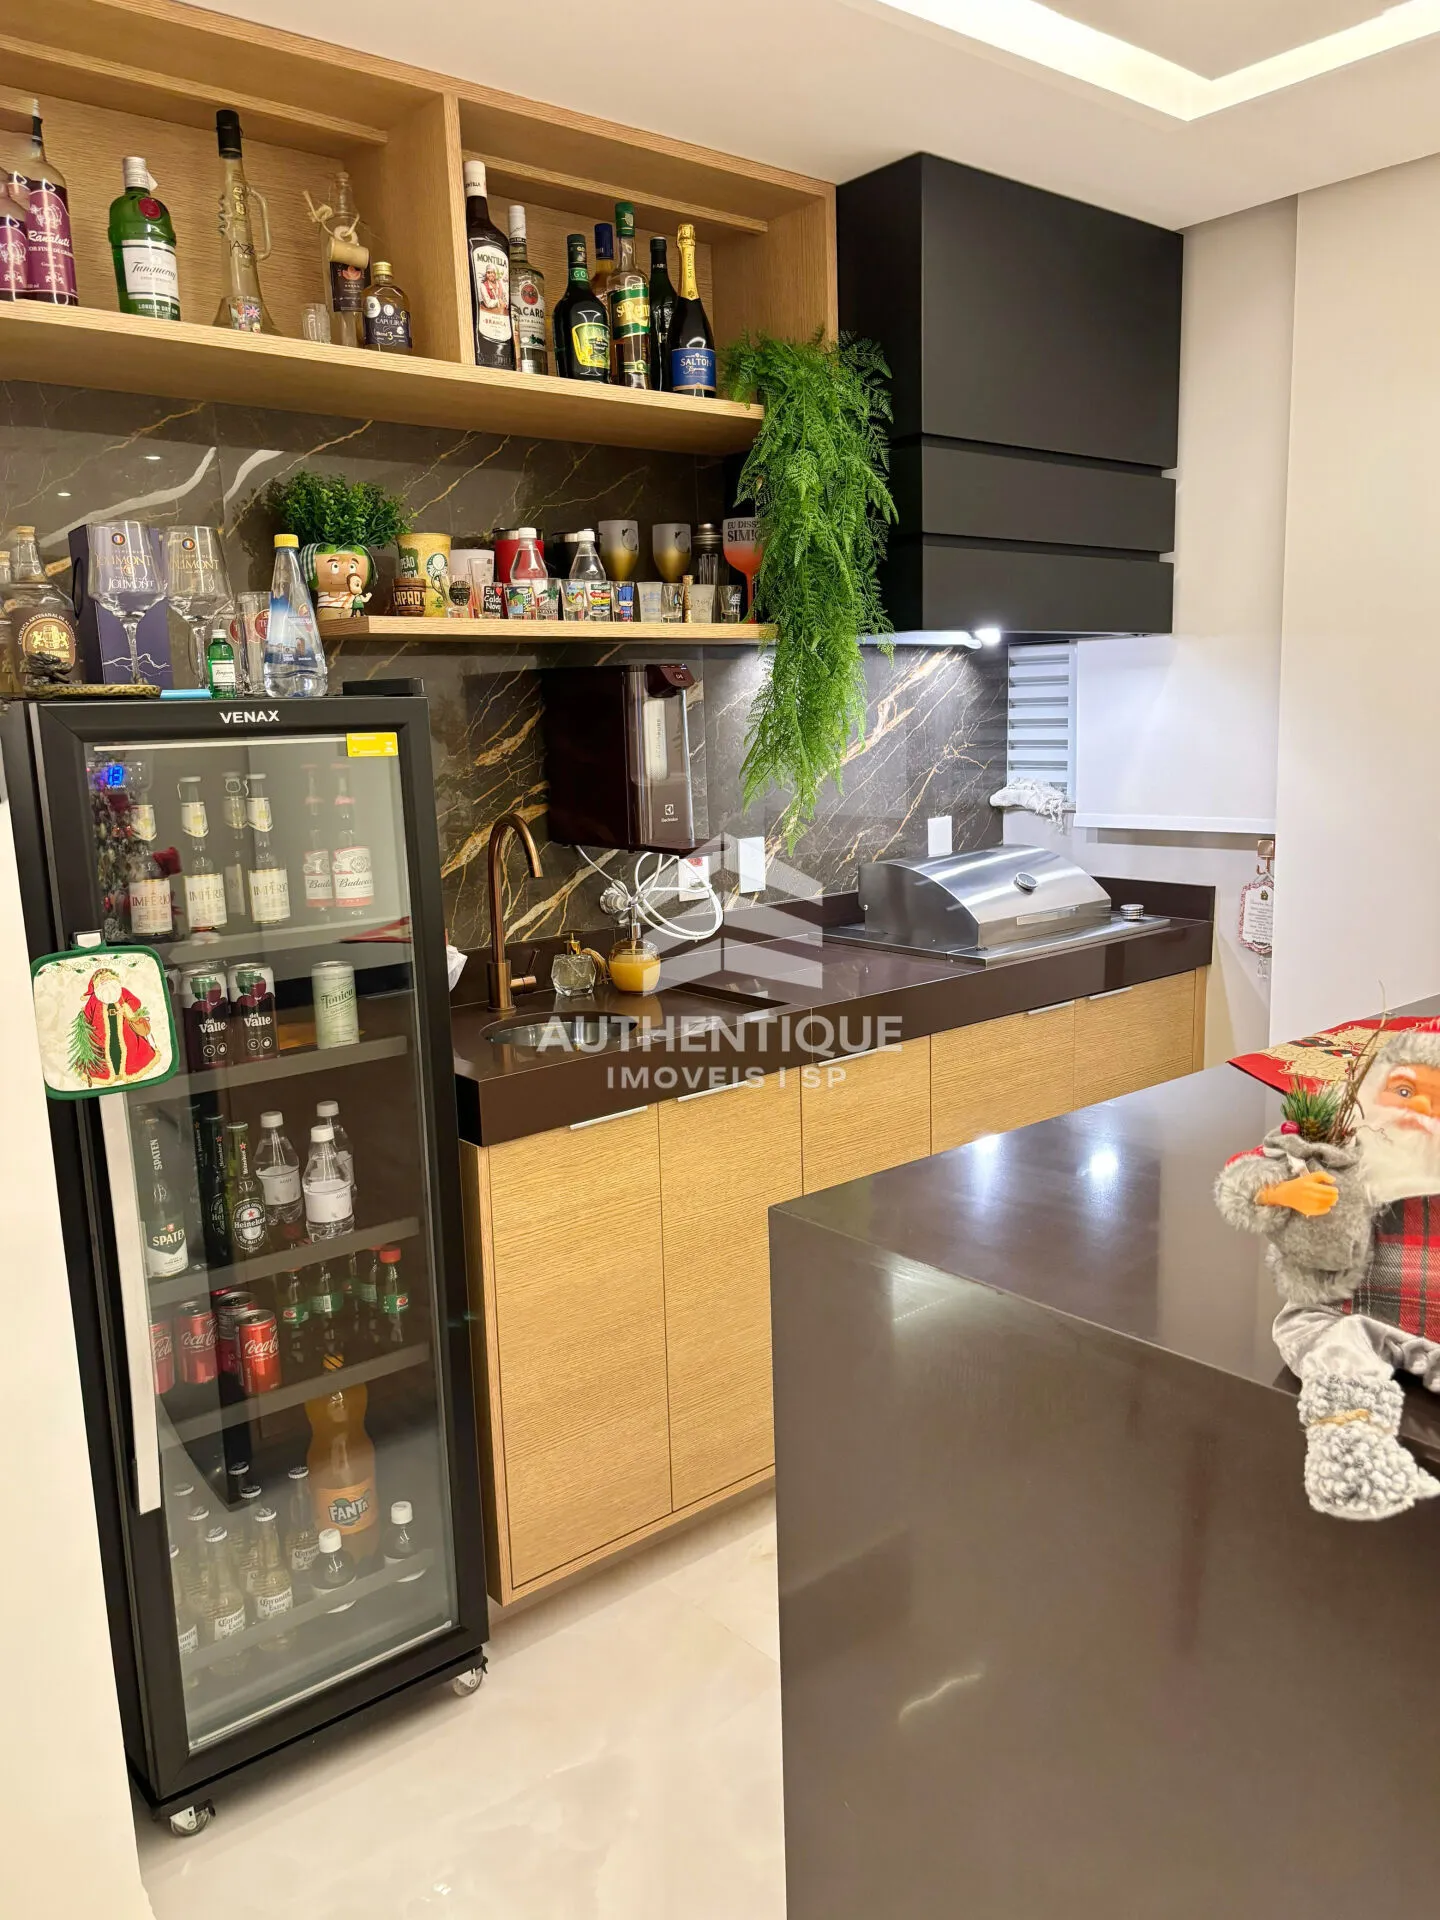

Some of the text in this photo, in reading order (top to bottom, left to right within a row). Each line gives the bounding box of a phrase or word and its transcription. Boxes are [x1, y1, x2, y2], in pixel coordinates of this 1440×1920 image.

[477, 254, 508, 268] MONTILLA
[132, 261, 177, 280] Tanqueray
[138, 304, 160, 312] LONDON
[519, 306, 544, 319] ACARD
[680, 358, 712, 367] SALTON
[727, 522, 736, 530] EU
[485, 587, 494, 595] Eu
[219, 710, 280, 724] VENAX
[199, 1021, 228, 1034] Valle
[243, 1016, 273, 1028] Valle
[150, 1138, 162, 1171] SPATEN
[234, 1217, 267, 1229] Heineken
[328, 1498, 369, 1522] FANTA
